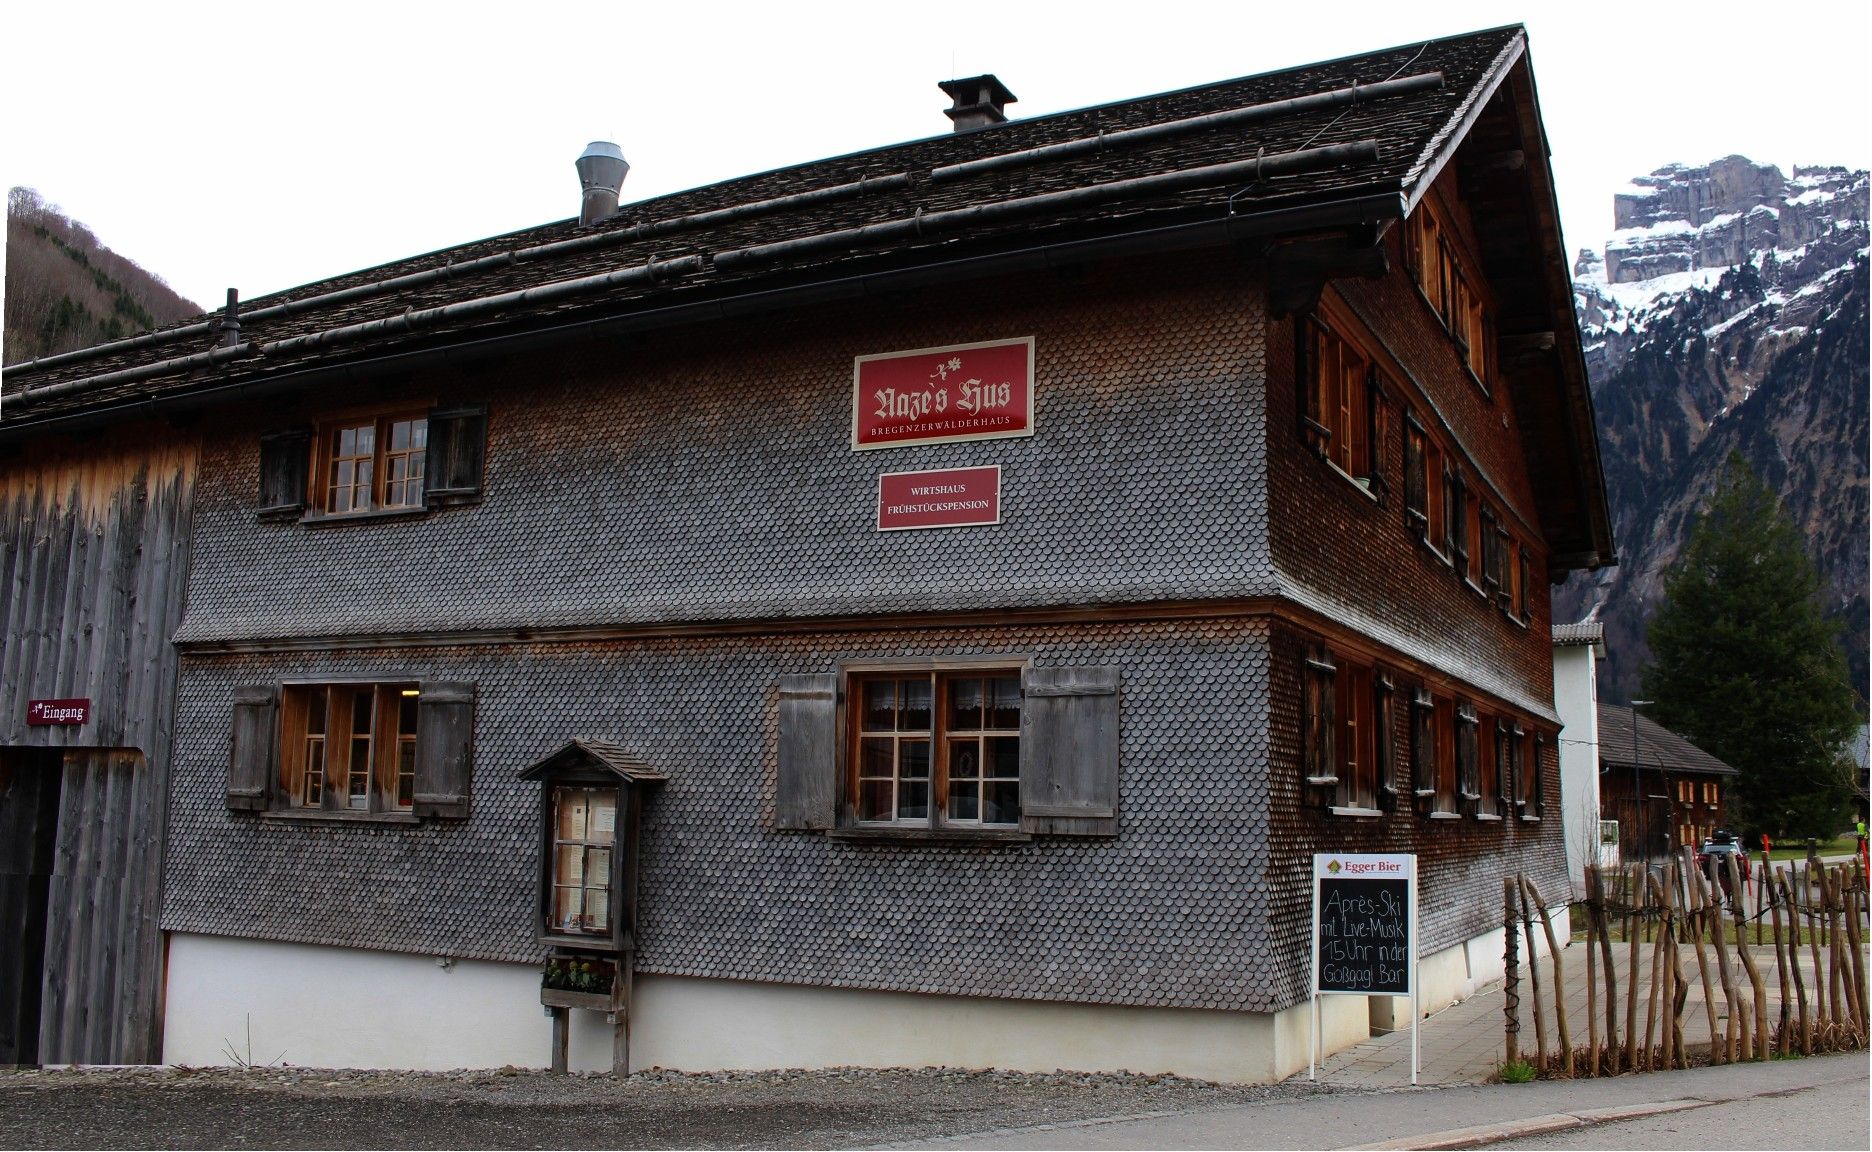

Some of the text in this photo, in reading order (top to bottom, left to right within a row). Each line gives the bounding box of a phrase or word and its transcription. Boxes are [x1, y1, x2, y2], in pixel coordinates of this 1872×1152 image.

[956, 378, 1011, 417] Hus
[871, 416, 1010, 436] BREGENZERWÄLDERHAUS
[911, 484, 966, 496] WIRTSHAUS
[887, 500, 989, 515] FRÜHSTÜCKSPENSION
[42, 705, 84, 721] Eingang
[1344, 861, 1402, 873] Egger Bier
[1324, 889, 1401, 917] Après-Ski
[1342, 915, 1405, 938] Live-Musik
[1322, 940, 1345, 961] 15
[1346, 939, 1374, 962] Uhr
[1390, 942, 1408, 961] der
[1378, 963, 1405, 984] Bar
